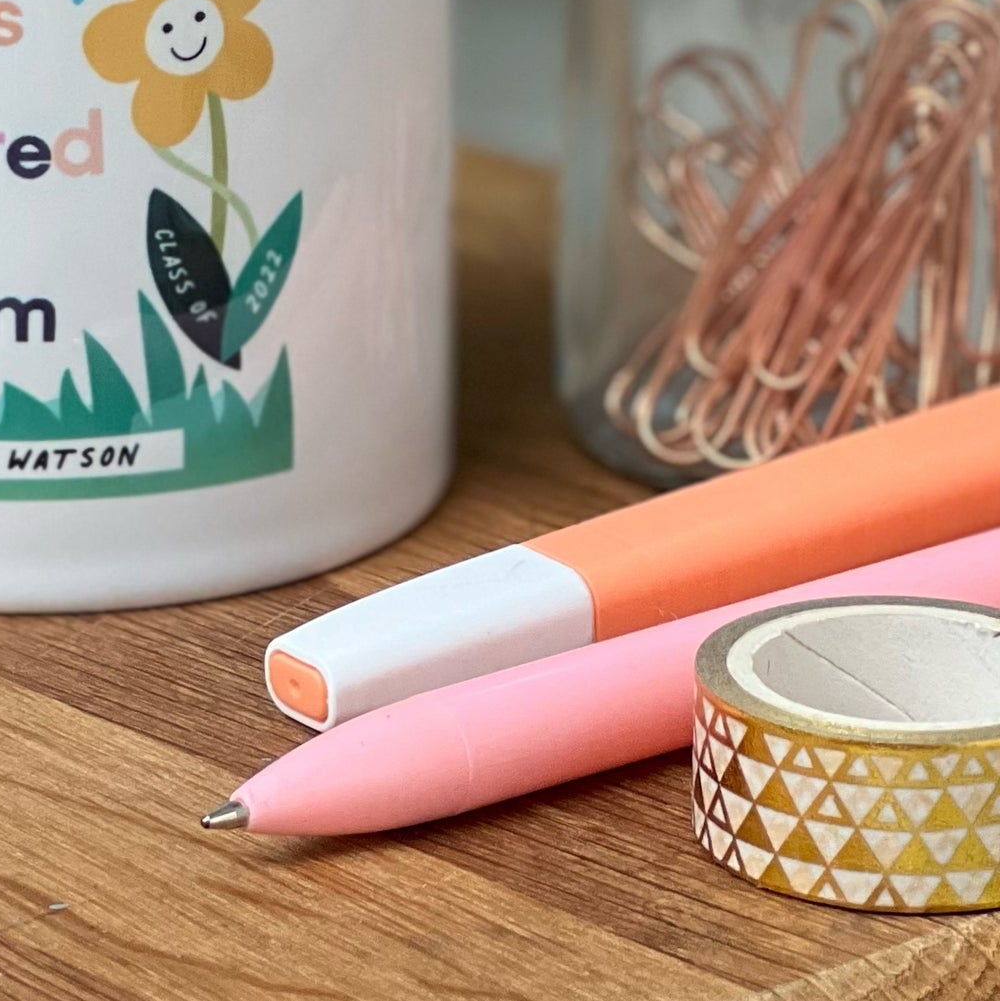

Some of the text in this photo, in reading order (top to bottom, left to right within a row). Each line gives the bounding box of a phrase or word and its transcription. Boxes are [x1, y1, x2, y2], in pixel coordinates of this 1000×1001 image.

[155, 229, 218, 322] CLASS OF
[246, 250, 282, 313] 2022
[7, 443, 140, 470] WATSON
